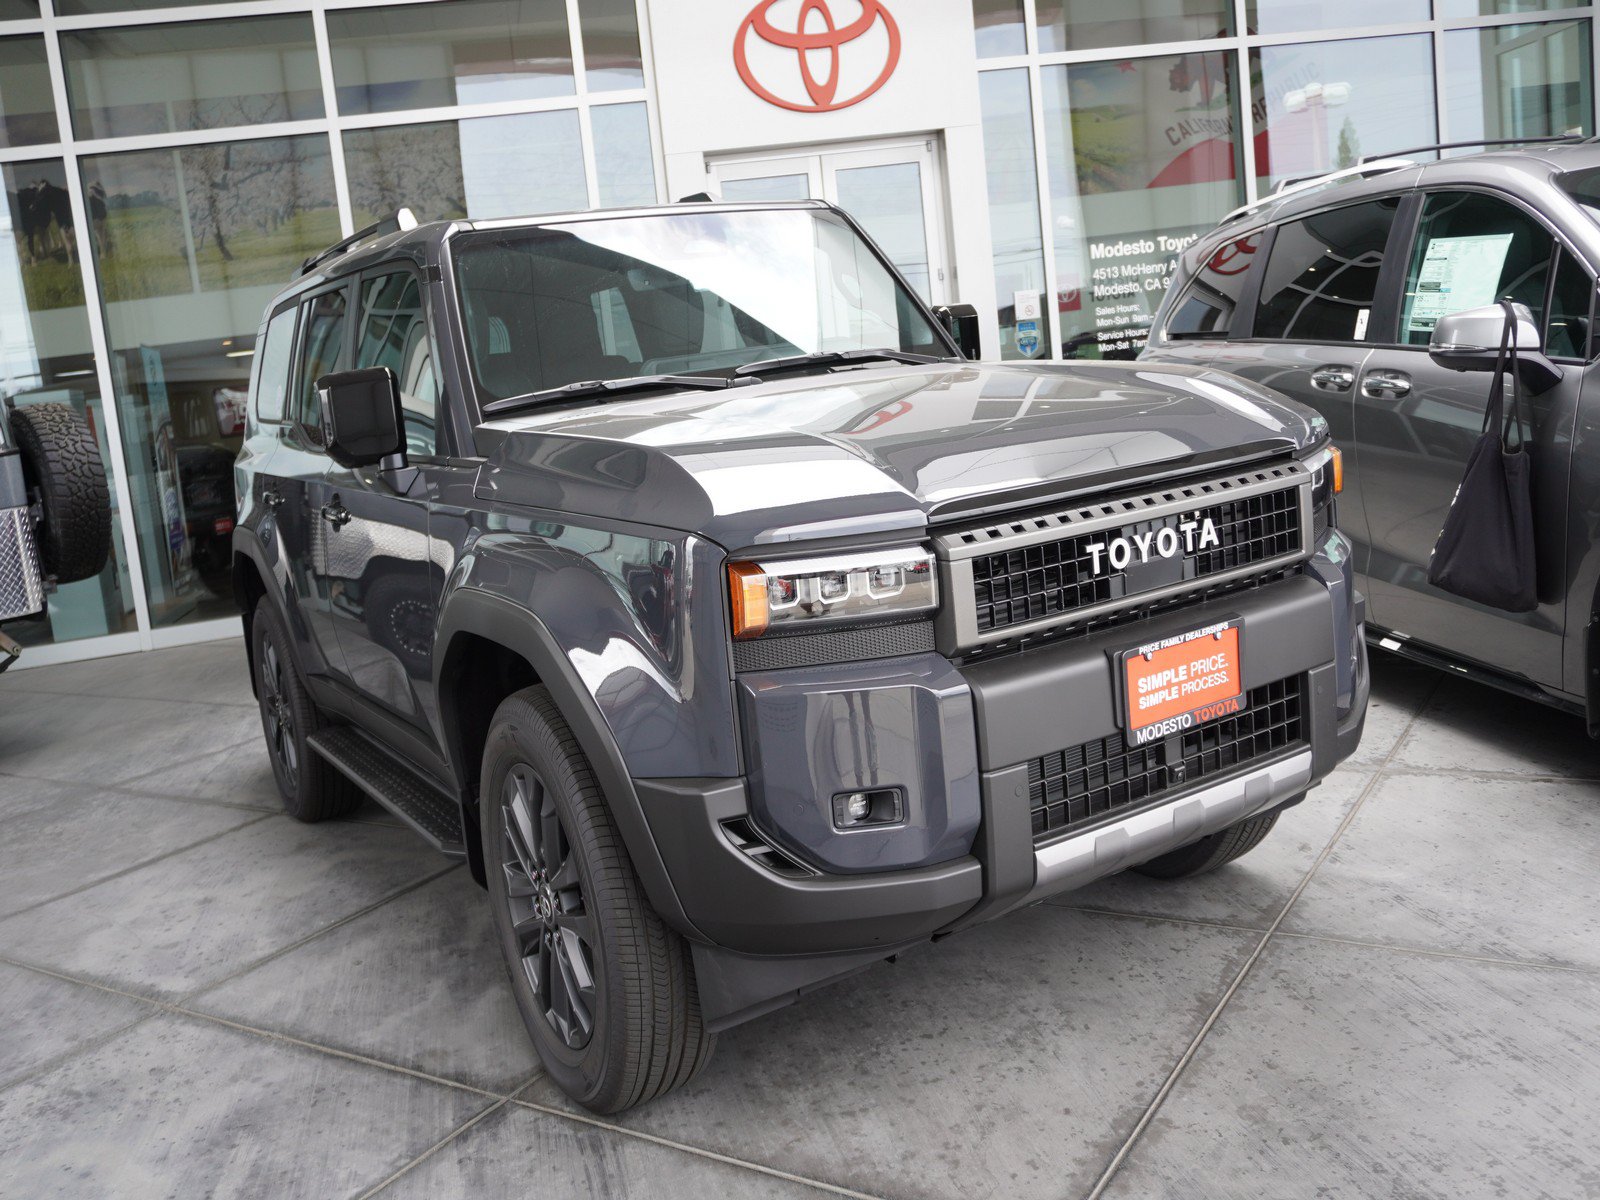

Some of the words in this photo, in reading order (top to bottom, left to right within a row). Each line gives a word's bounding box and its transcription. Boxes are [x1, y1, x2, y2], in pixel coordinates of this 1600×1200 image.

[1090, 239, 1155, 259] Modesto
[1156, 233, 1199, 253] Toyot
[1093, 266, 1119, 280] 4513
[1122, 262, 1168, 277] McHenry
[1093, 283, 1142, 297] Modesto,
[1144, 278, 1161, 291] CA
[1095, 307, 1116, 316] Sales
[1117, 304, 1140, 313] Hours:
[1096, 316, 1130, 327] Mon-Sun
[1132, 314, 1148, 323] 9am
[1097, 331, 1124, 341] Service
[1125, 328, 1149, 338] Hours:
[1098, 341, 1130, 352] Mon-Sat
[1086, 518, 1219, 575] TOYOTA
[1138, 642, 1160, 655] PRICE
[1160, 636, 1185, 650] FAMILY
[1185, 622, 1230, 642] DEALERSHIPS
[1137, 665, 1188, 694] SIMPLE
[1190, 652, 1230, 676] PRICE.
[1138, 685, 1179, 710] SIMPLE
[1181, 671, 1230, 697] PROCESS.
[1137, 713, 1192, 744] MODESTO
[1193, 698, 1240, 725] TOYOTA
